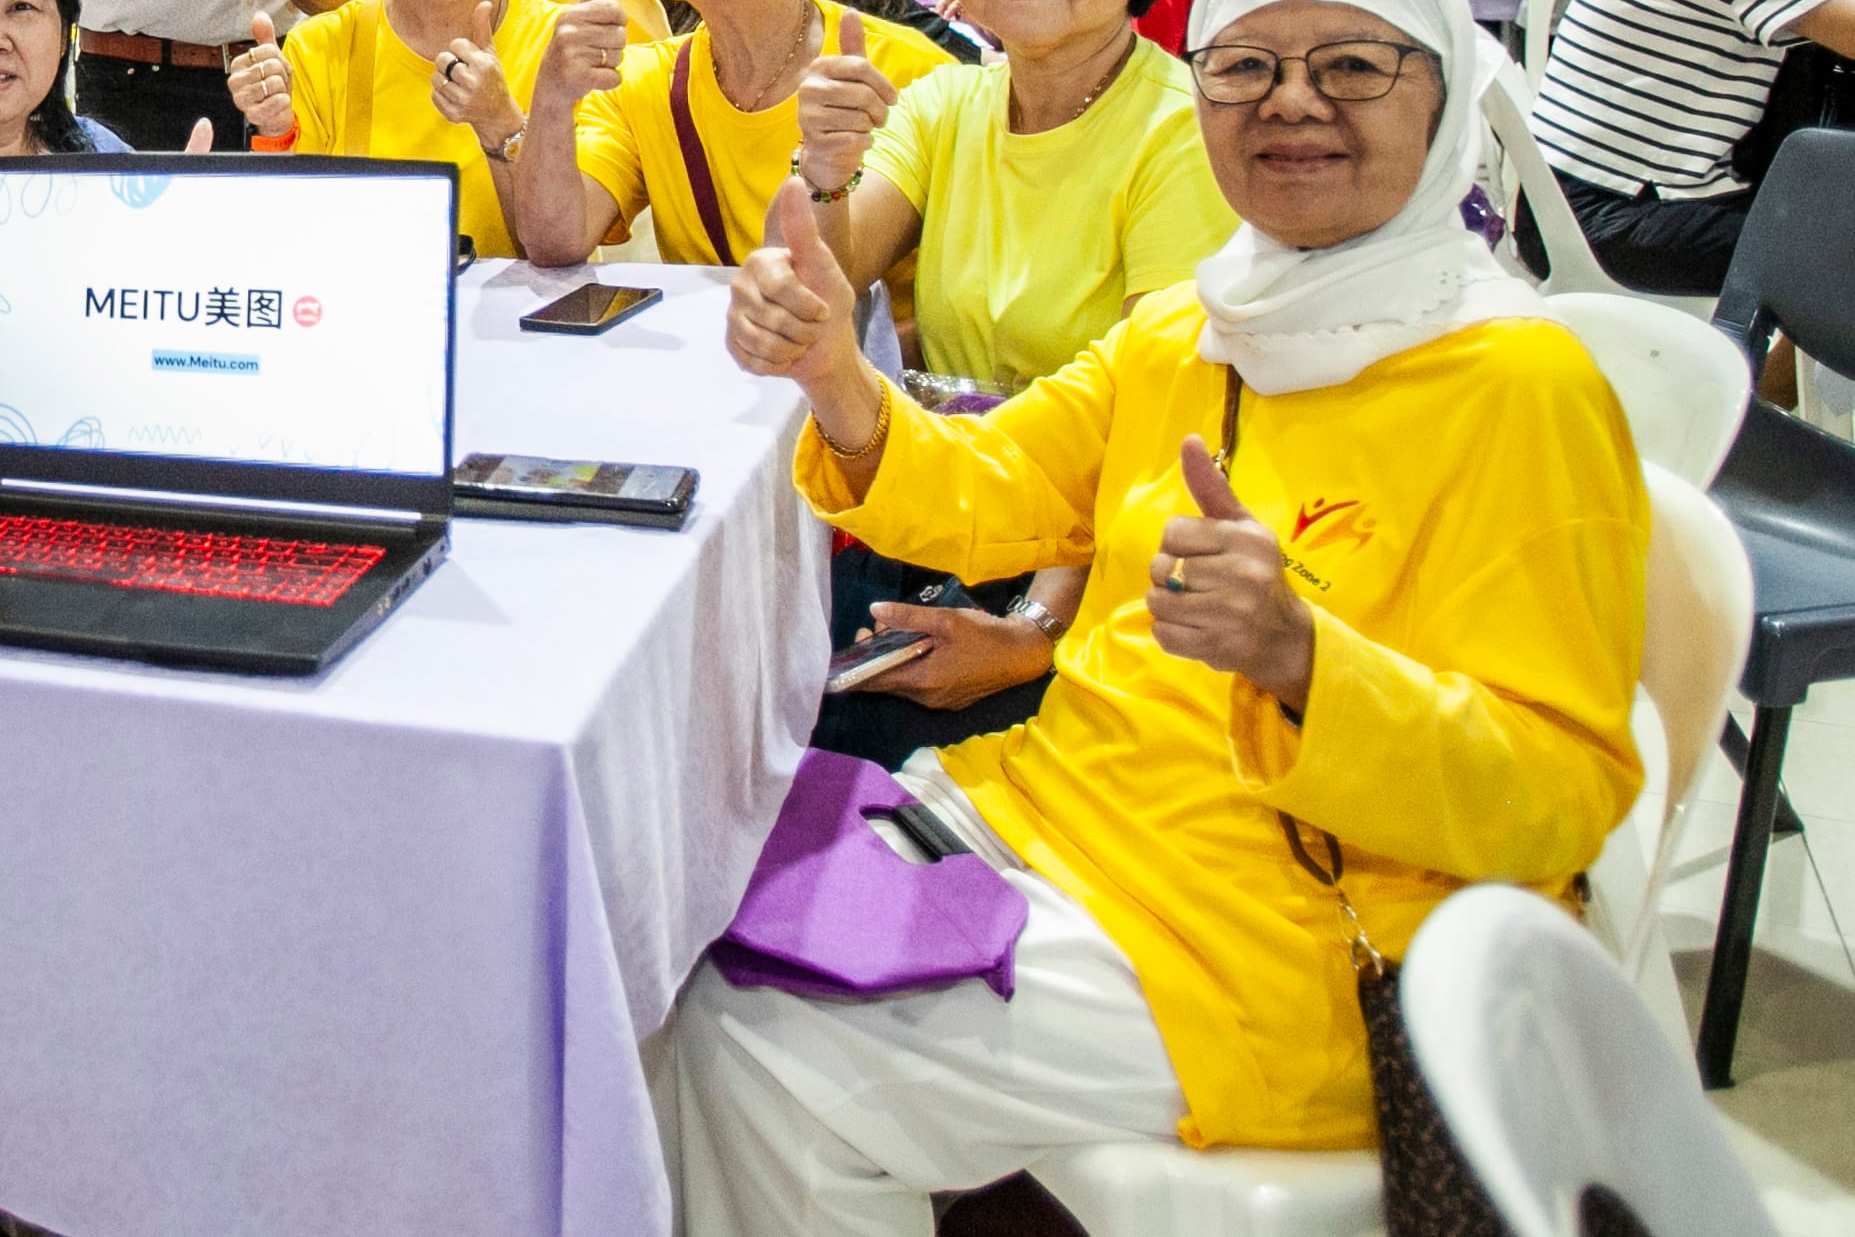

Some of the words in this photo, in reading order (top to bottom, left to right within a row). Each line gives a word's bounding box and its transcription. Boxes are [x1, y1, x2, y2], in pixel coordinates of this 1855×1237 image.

[154, 355, 259, 372] www.Meitu.com
[1292, 561, 1320, 586] Zone
[1319, 580, 1331, 592] 2
